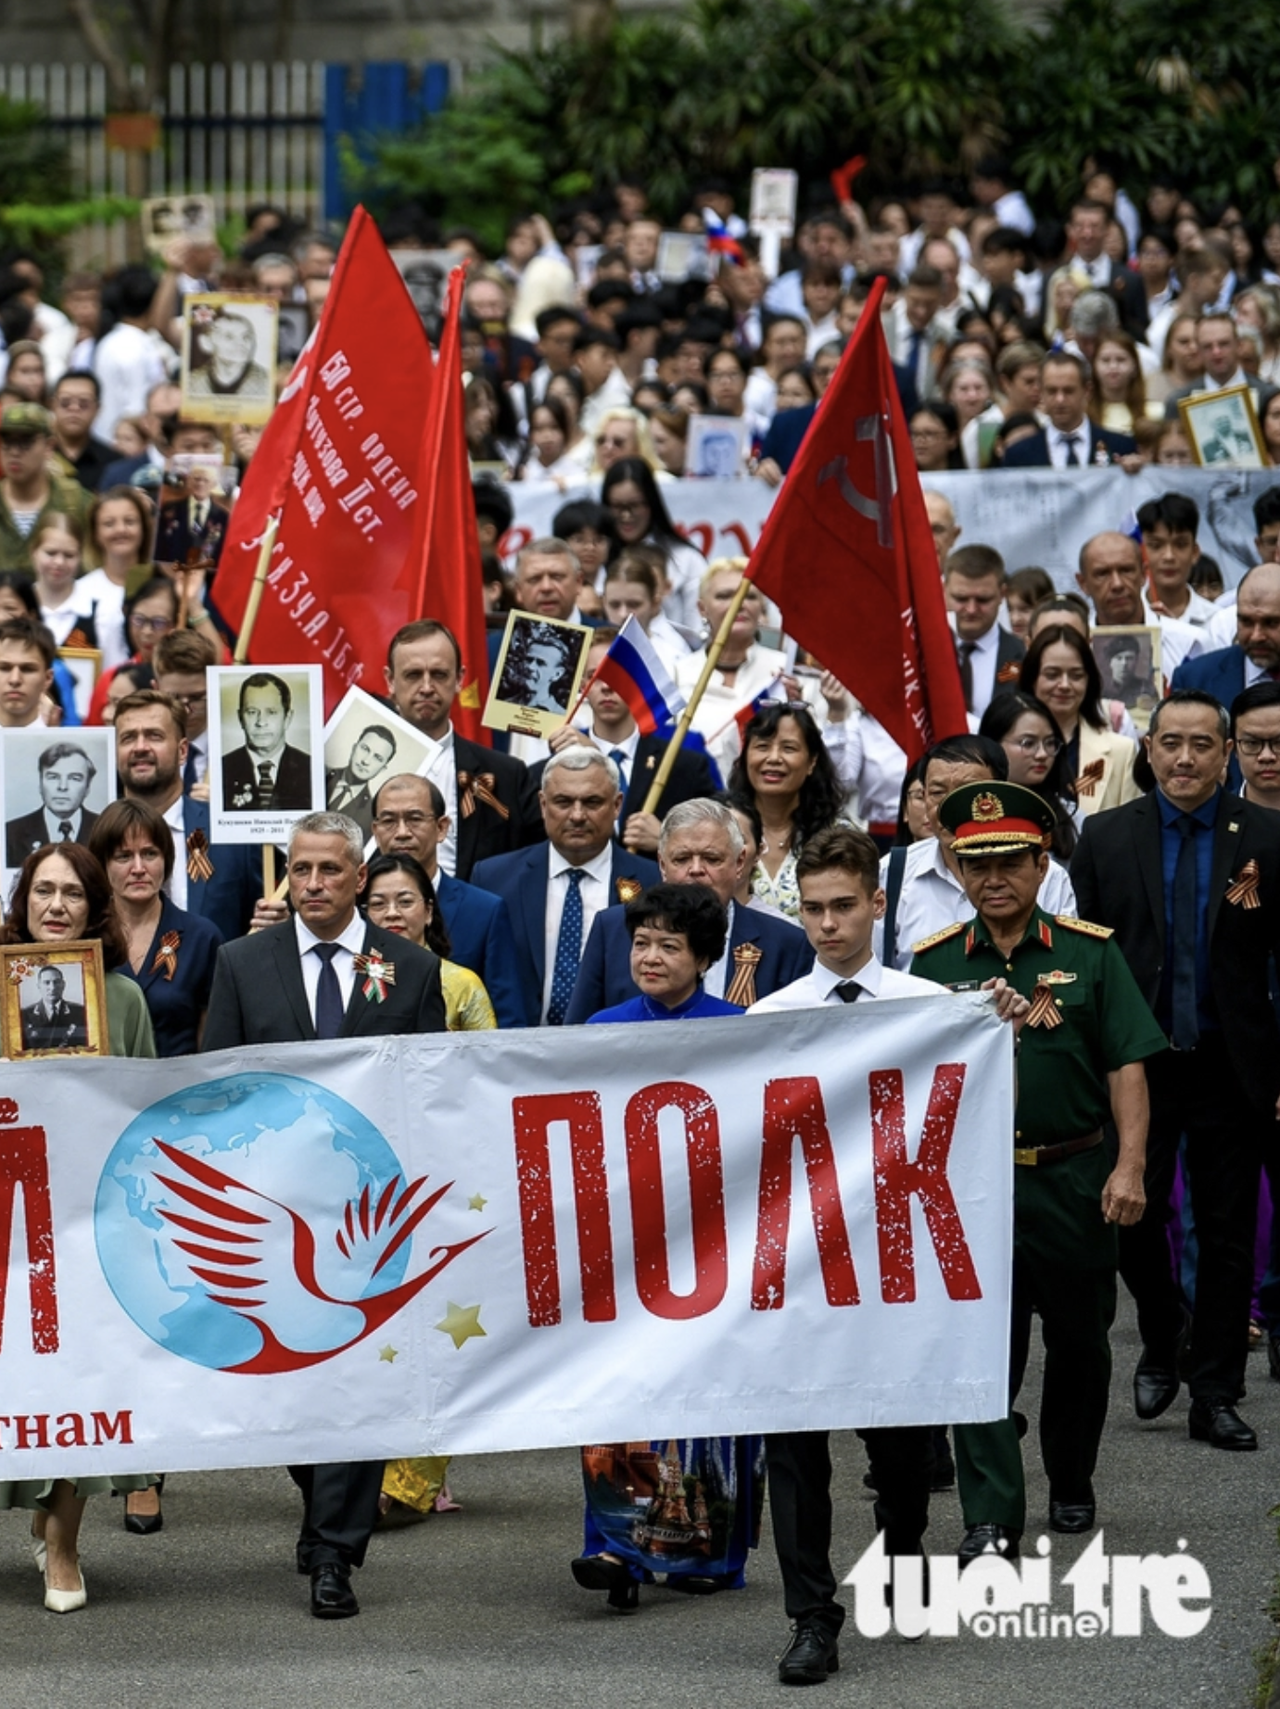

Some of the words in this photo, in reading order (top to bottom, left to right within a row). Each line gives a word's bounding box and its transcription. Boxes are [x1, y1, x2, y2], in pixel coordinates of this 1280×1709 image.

[319, 350, 351, 391] 150
[360, 433, 418, 510] ОРДЕНА
[512, 1063, 982, 1327] ПОЛК
